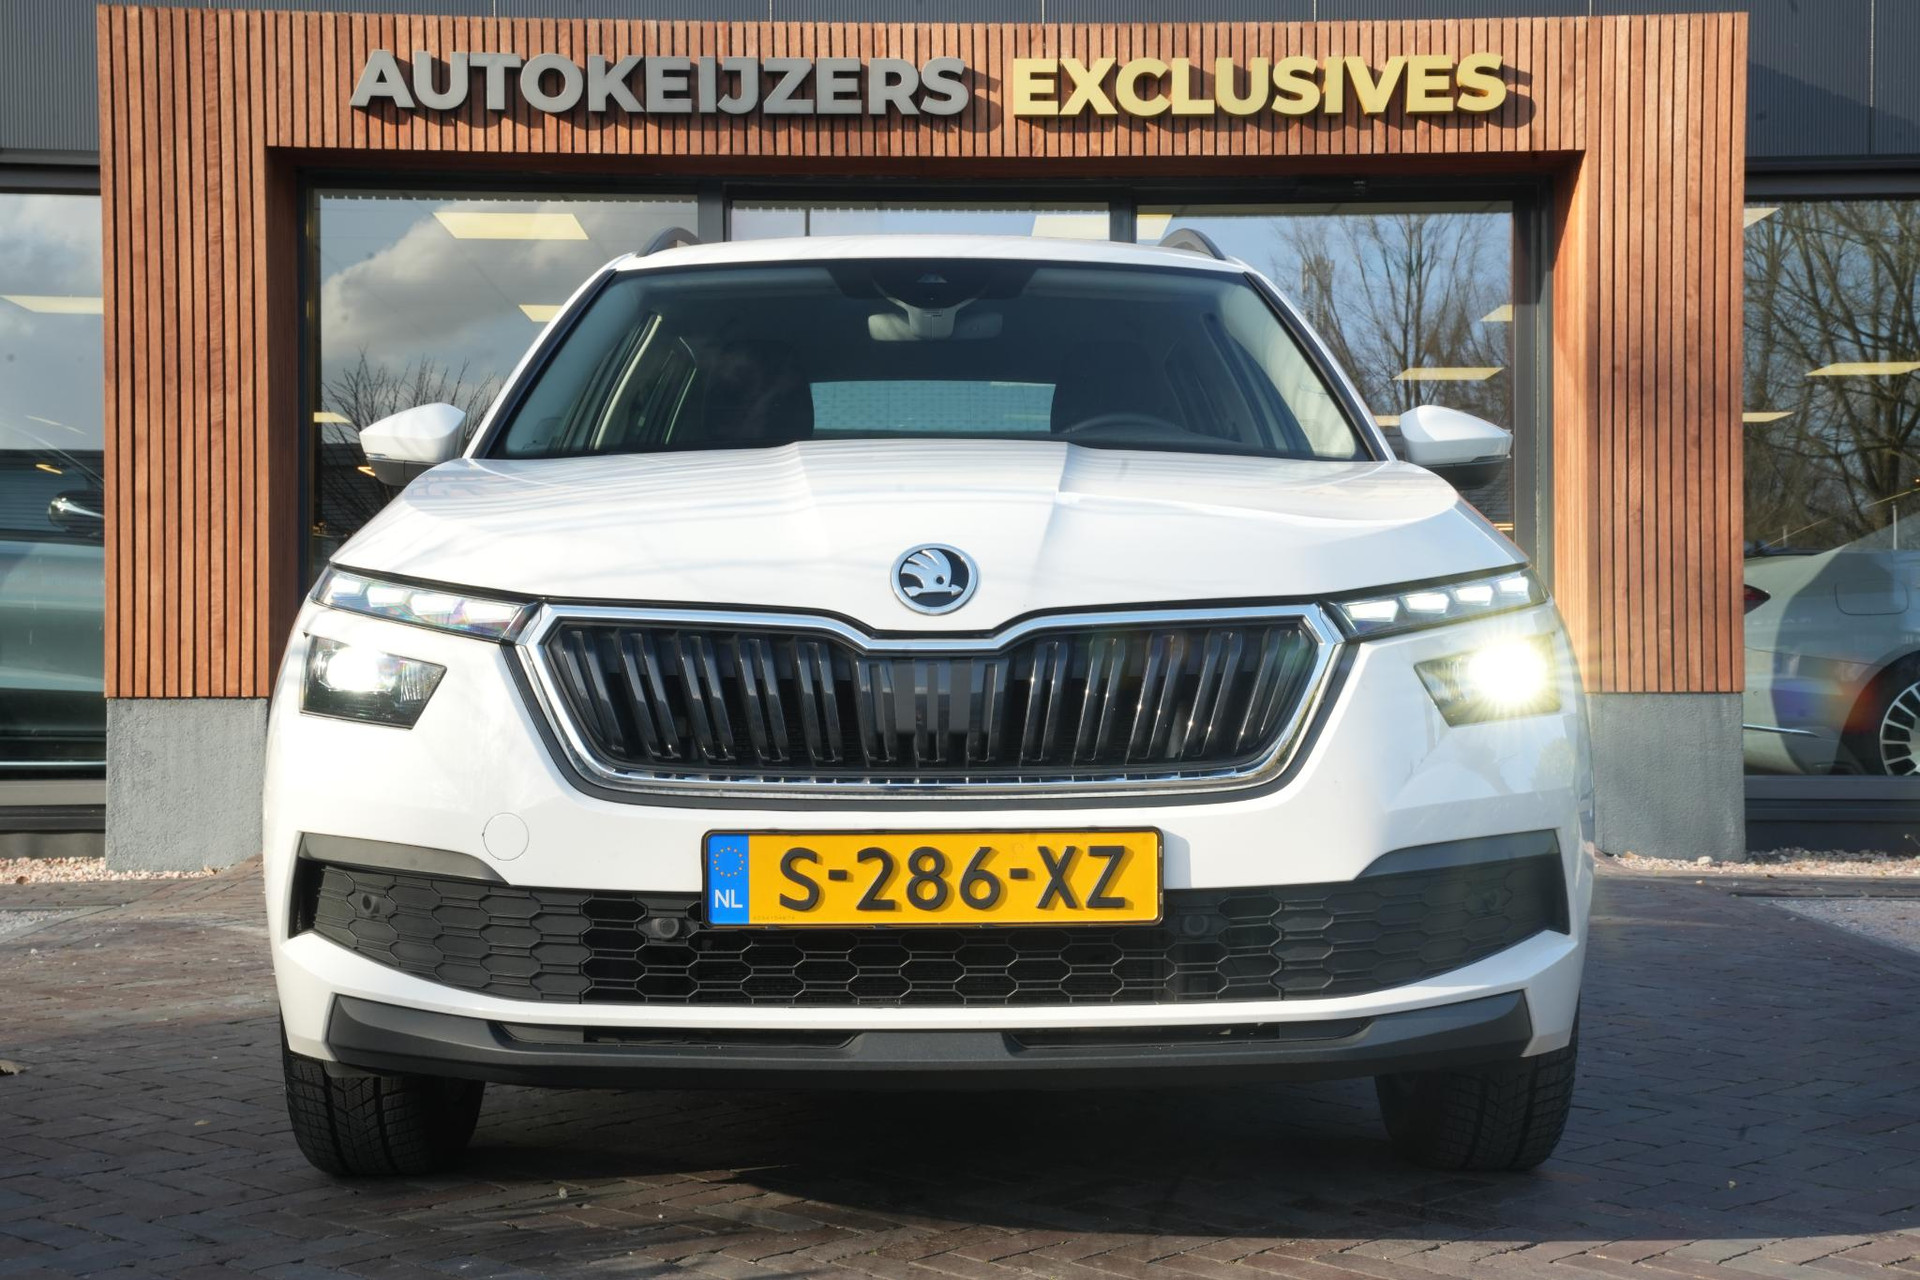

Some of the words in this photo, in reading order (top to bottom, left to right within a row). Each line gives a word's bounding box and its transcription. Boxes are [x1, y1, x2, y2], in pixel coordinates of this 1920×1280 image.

[349, 49, 970, 115] AUTOKEIJZERS
[1013, 52, 1508, 117] EXCLUSIVES
[714, 889, 743, 909] NL
[779, 846, 1127, 911] S-286-XZ
